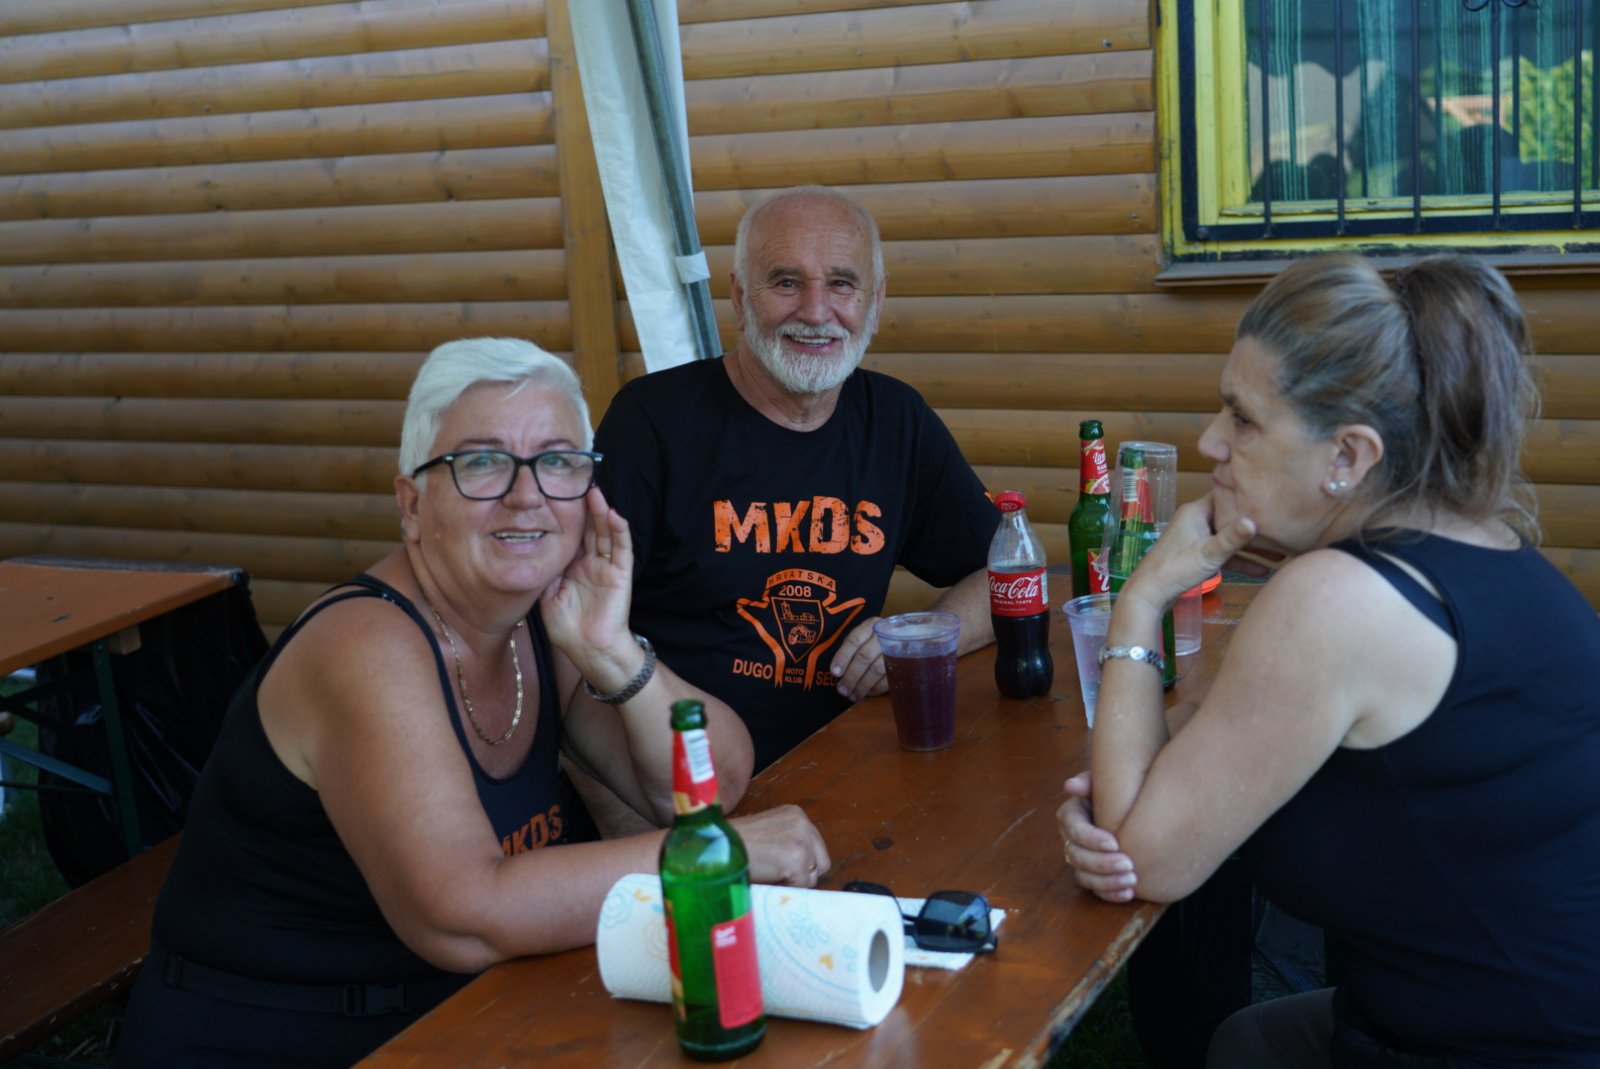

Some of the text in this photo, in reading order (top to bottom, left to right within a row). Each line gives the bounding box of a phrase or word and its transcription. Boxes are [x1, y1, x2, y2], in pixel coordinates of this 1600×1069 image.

[713, 496, 885, 555] MKDS
[768, 571, 833, 589] HRVATSKA
[990, 575, 1040, 599] Coca-Cola
[778, 585, 812, 598] 2008
[733, 658, 839, 686] DUGO SEL
[784, 676, 803, 684] KLUB
[785, 668, 804, 676] MOTO
